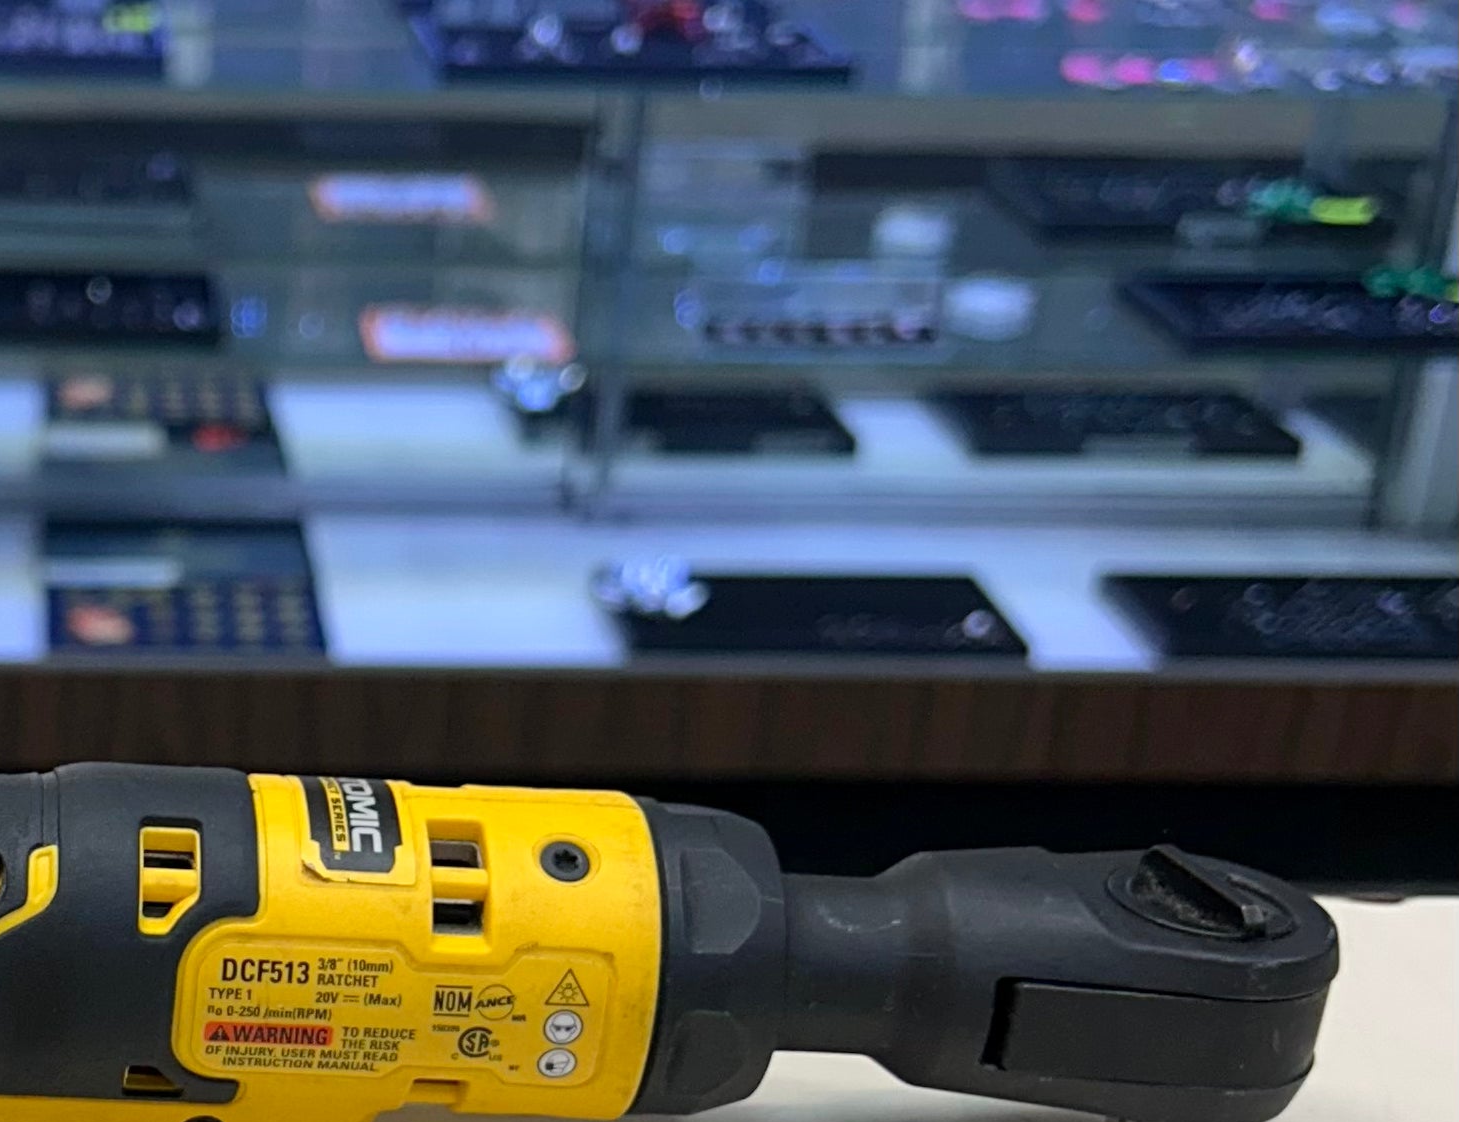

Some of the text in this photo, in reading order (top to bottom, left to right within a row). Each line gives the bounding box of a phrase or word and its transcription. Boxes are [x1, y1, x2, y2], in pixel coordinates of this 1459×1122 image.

[331, 797, 346, 842] SERIES
[221, 957, 310, 984] DCF513
[347, 958, 393, 974] (10mm)
[317, 973, 379, 988] RATCHET
[208, 987, 252, 1000] TYPE 1
[315, 991, 402, 1008] 20V (Max)
[433, 990, 472, 1012] NOM
[475, 994, 516, 1010] ANCE
[226, 1005, 260, 1018] 0-250
[233, 1025, 329, 1046] WARNING
[342, 1026, 416, 1040] TO REDUCE
[341, 1039, 401, 1051] THE RISK
[205, 1045, 222, 1055] OF
[281, 1048, 316, 1059] USER
[319, 1049, 358, 1060] MUST
[363, 1051, 399, 1062] READ
[222, 1057, 315, 1069] INSTRUCTION
